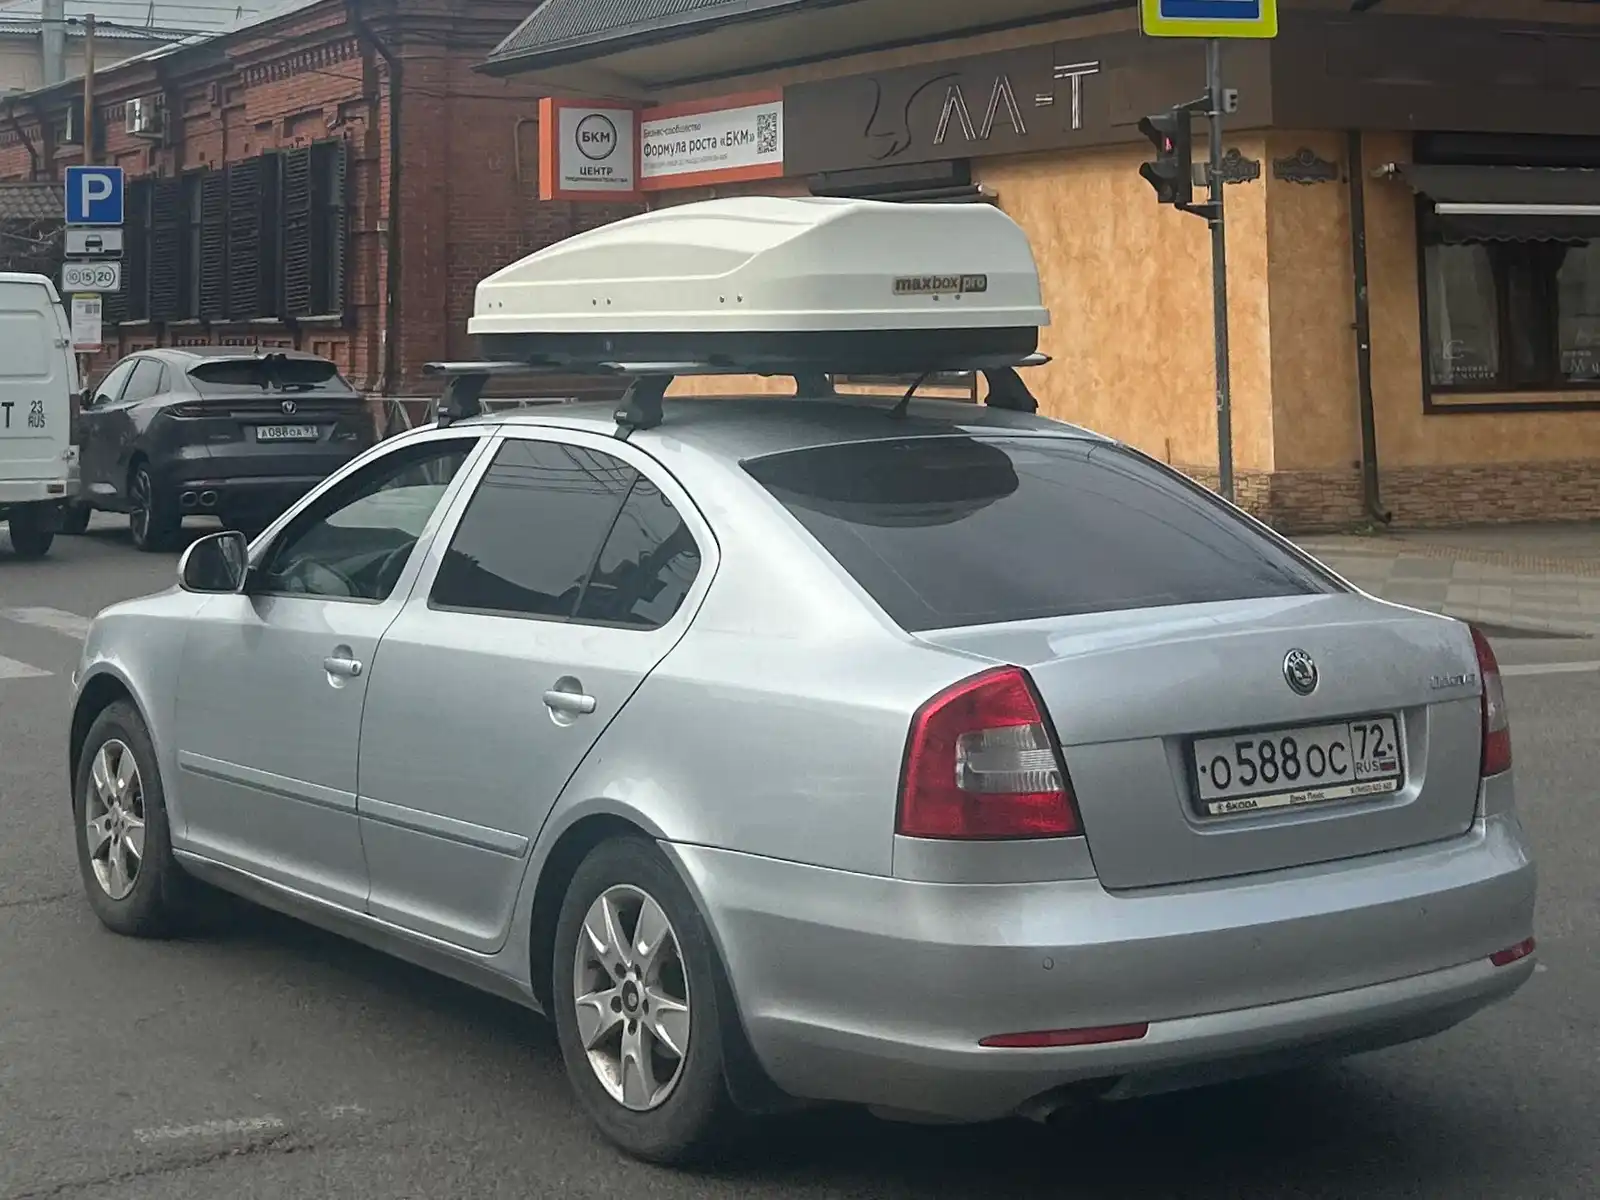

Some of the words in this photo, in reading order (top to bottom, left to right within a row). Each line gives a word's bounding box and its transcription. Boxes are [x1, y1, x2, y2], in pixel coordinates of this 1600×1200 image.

[582, 131, 610, 143] БКМ
[643, 142, 687, 158] Формула
[689, 137, 717, 155] роста
[720, 129, 755, 147] «БКМ»
[579, 166, 614, 176] ЦЕНТР
[81, 173, 113, 218] P
[67, 271, 78, 282] 10
[81, 271, 92, 282] 15
[97, 271, 112, 282] 20
[895, 275, 958, 291] maxbox
[30, 400, 44, 414] 23
[28, 413, 46, 428] RUS
[1353, 724, 1387, 760] 72
[1356, 761, 1380, 775] RUS
